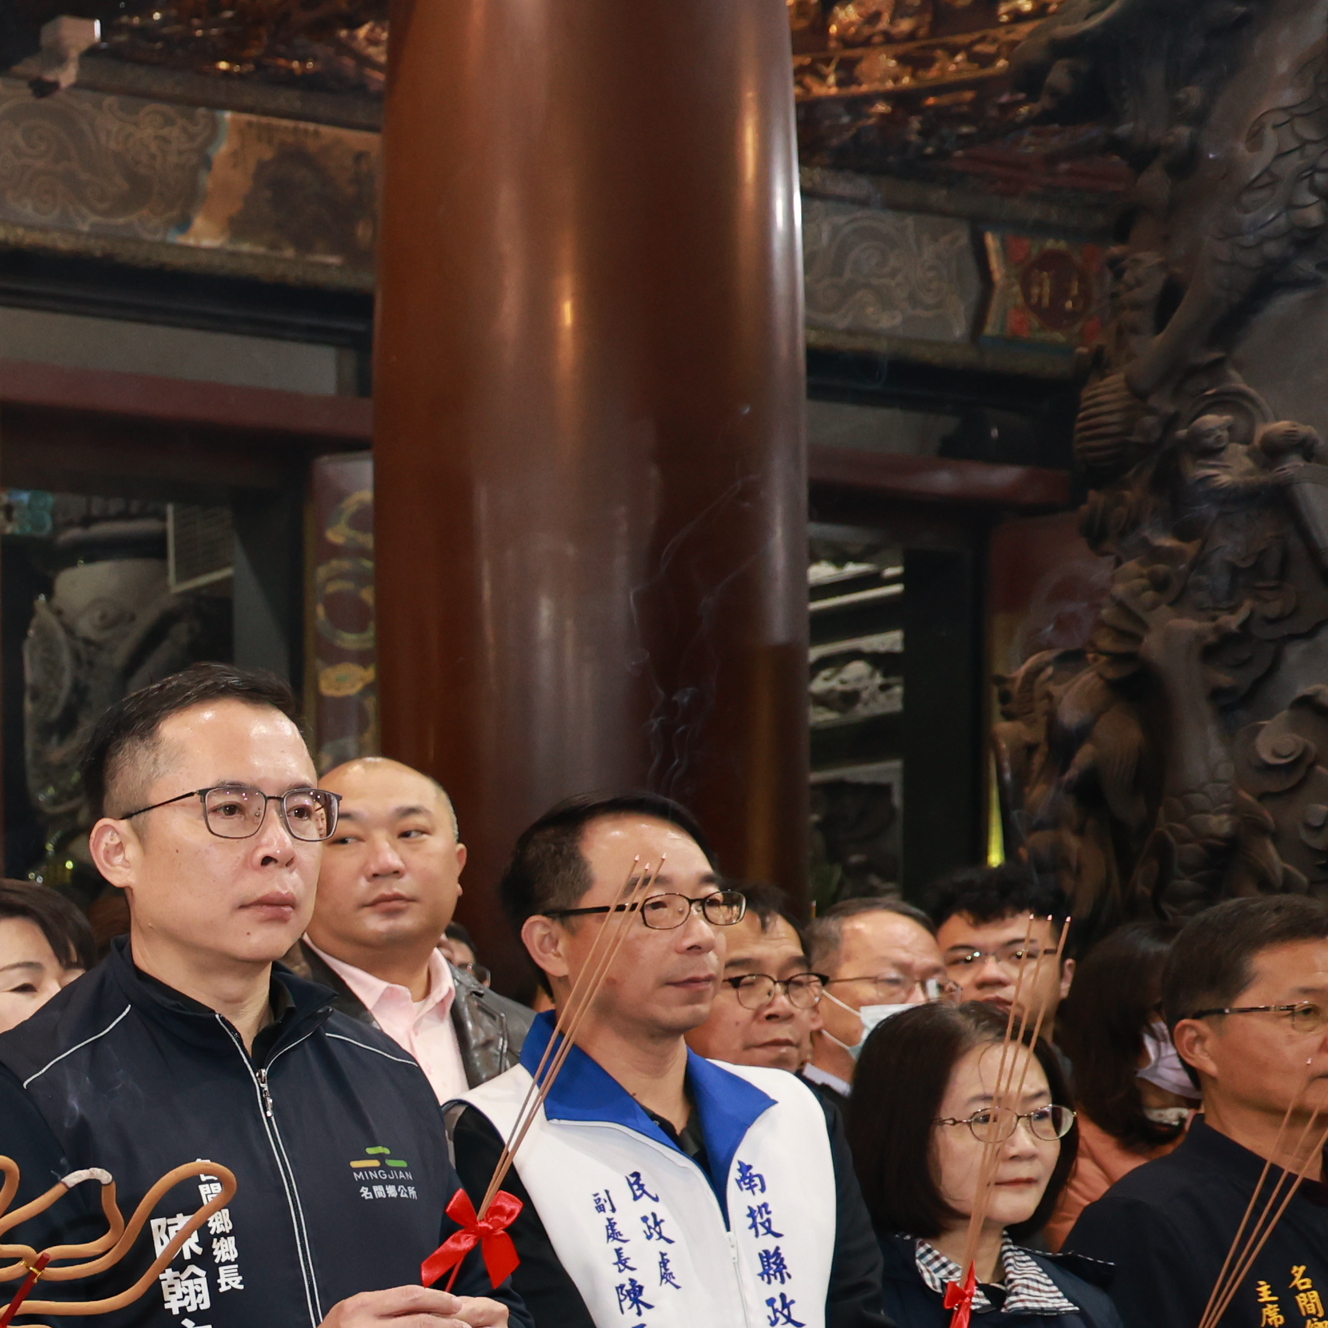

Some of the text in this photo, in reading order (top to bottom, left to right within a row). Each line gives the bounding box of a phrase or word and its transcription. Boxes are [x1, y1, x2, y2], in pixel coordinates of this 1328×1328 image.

[353, 1170, 413, 1181] MINGJIAN
[359, 1185, 418, 1200] 名間鄉公所
[625, 1171, 682, 1290] 民政處
